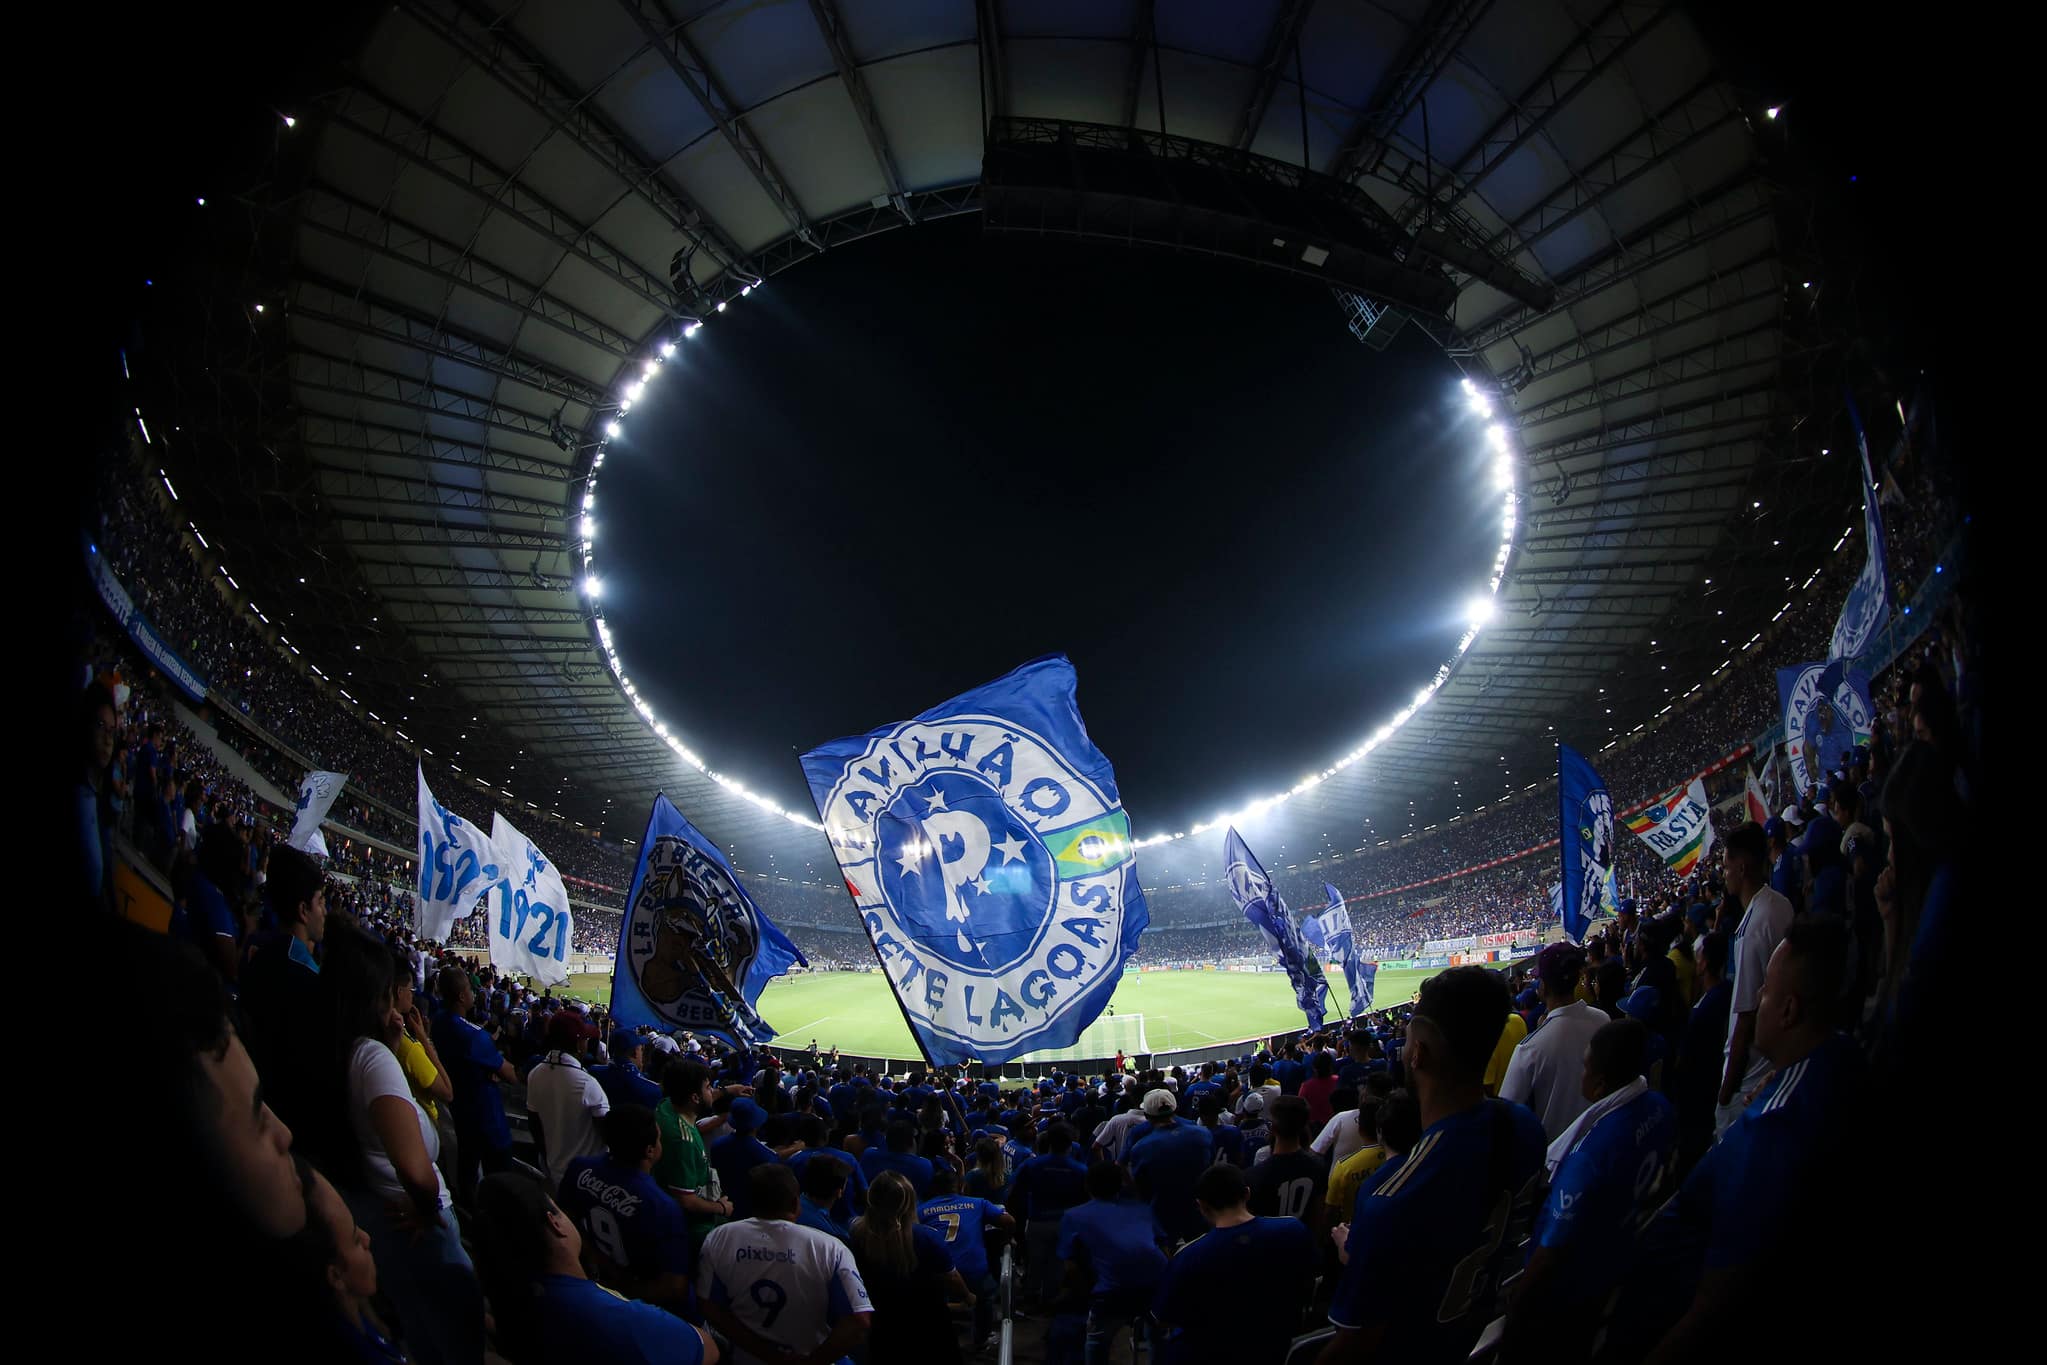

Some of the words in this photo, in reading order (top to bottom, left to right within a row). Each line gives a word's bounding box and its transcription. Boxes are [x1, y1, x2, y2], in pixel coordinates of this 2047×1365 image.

[1647, 800, 1708, 852] RASTA
[496, 877, 569, 962] 1921
[864, 911, 949, 1012] SETE
[963, 881, 1117, 1034] LAGOAS
[577, 1168, 643, 1217] Coca-Cola
[1277, 1177, 1314, 1218] 10
[938, 1212, 960, 1242] 7
[736, 1245, 796, 1264] pixbet
[750, 1278, 786, 1329] 9
